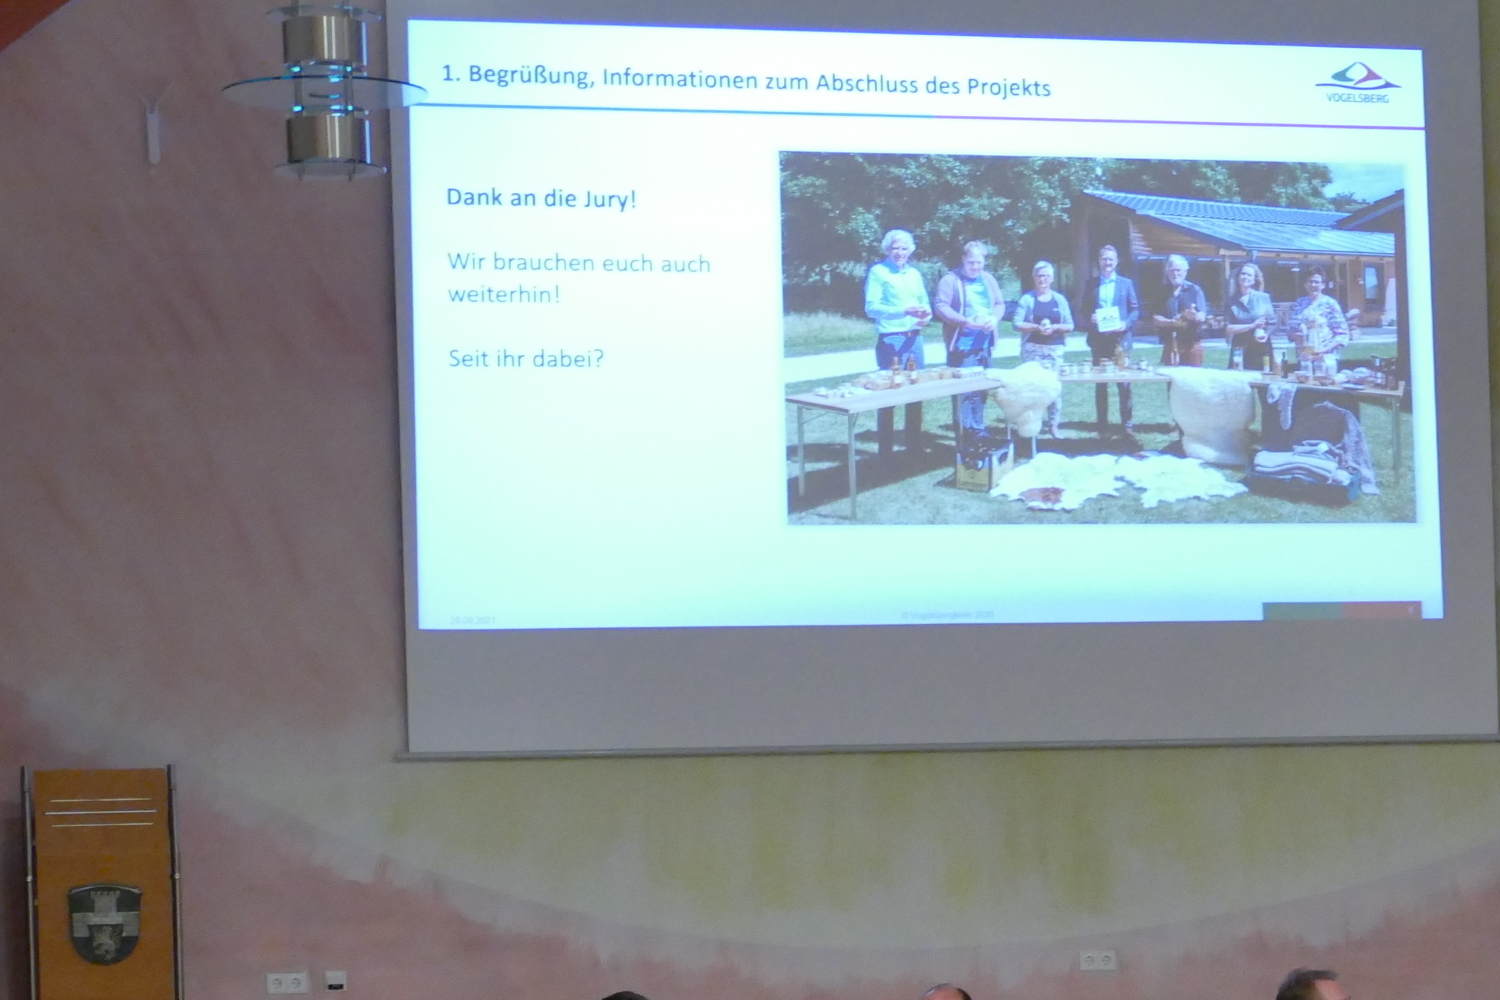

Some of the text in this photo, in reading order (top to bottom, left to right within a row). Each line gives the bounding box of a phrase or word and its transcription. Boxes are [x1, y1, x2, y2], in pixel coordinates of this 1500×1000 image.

[442, 64, 1051, 100] 1. Begrüßung, Informationen zum Abschluss des Projekts
[1326, 92, 1390, 104] VOGELSBERG
[447, 187, 636, 213] Dank an die Jury!
[448, 251, 711, 273] Wir brauchen euch auch
[448, 284, 560, 304] weiterhin!
[449, 348, 604, 368] Seit ihr dabei?
